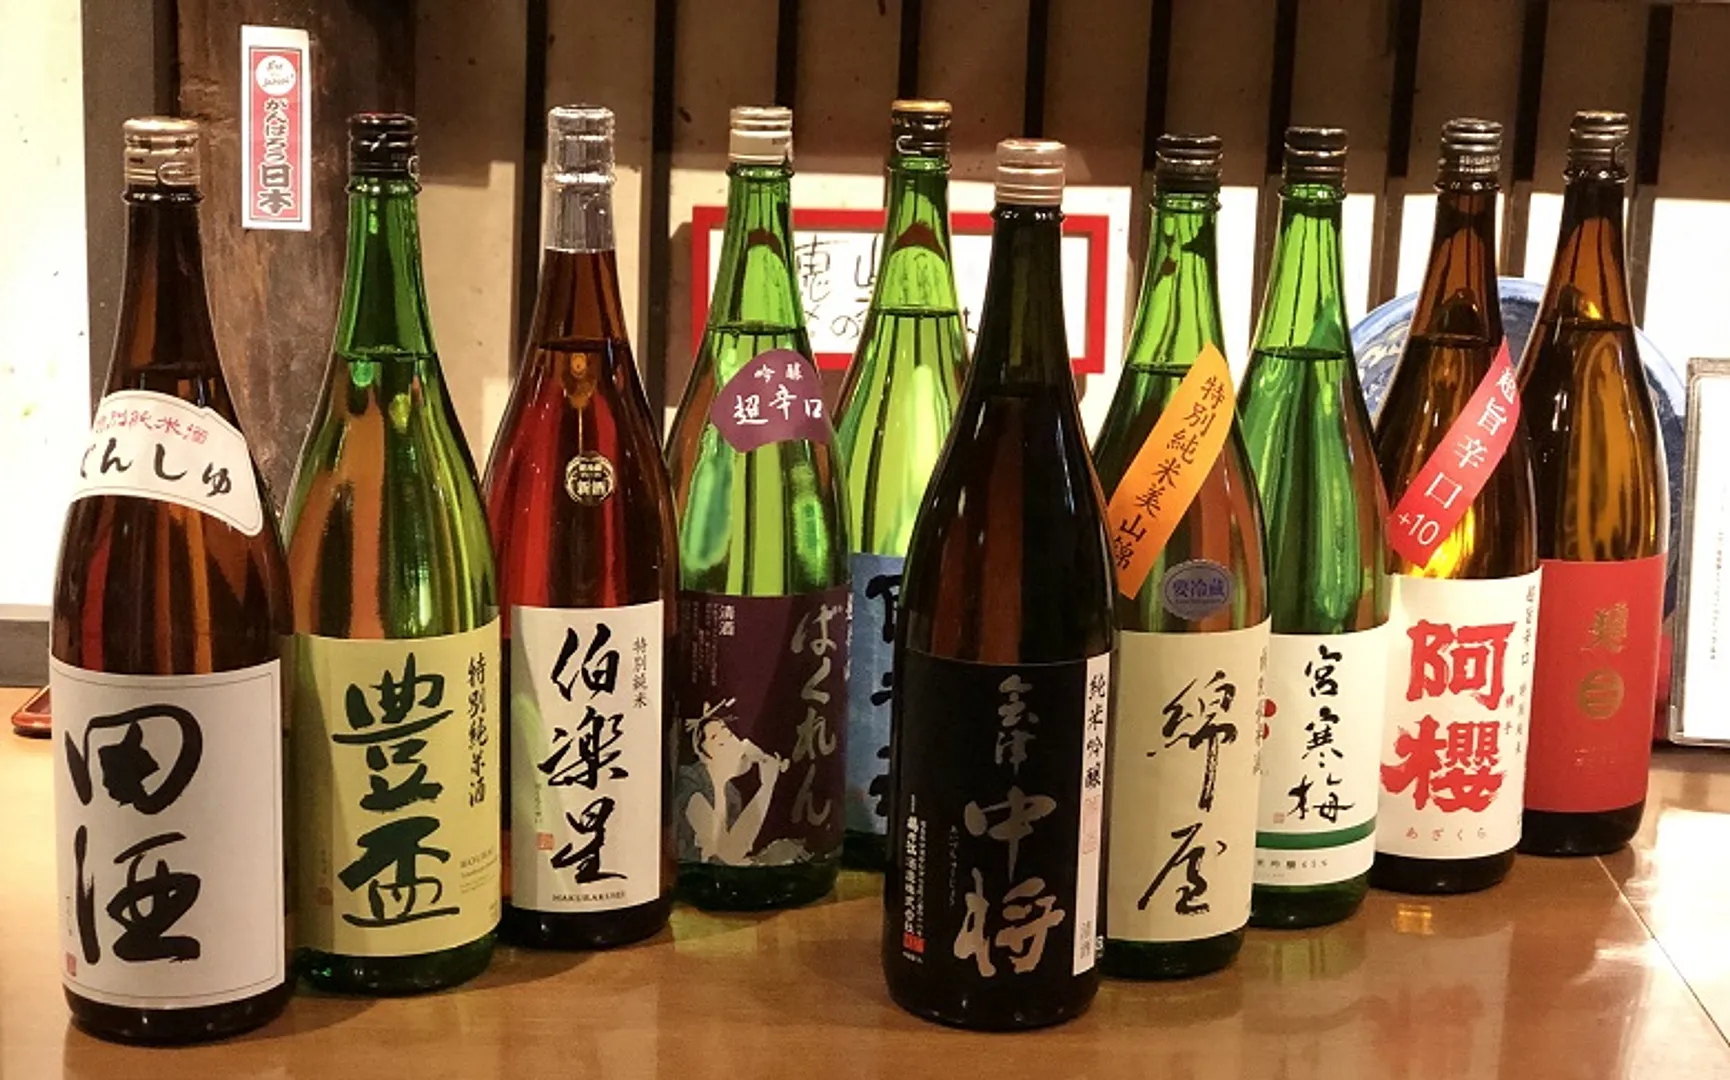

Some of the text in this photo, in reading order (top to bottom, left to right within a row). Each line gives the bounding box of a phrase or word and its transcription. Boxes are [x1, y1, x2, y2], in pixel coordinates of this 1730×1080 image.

[732, 383, 823, 426] 超辛口
[64, 703, 204, 964] 田酒
[537, 622, 629, 885] 伯楽星
[790, 603, 845, 828] ばくれん
